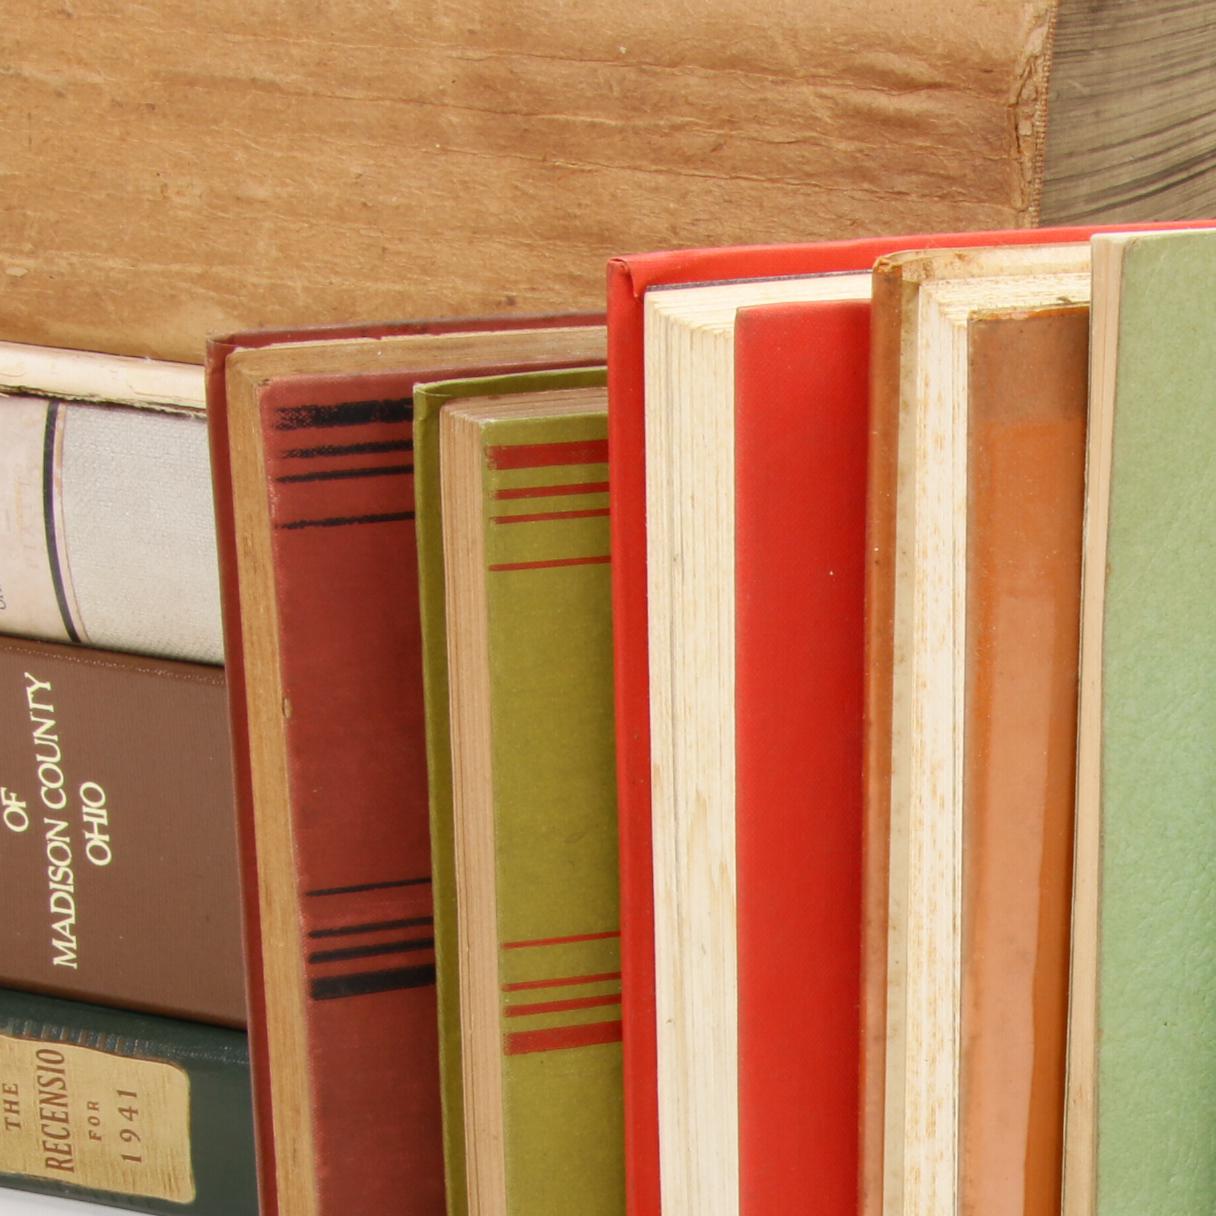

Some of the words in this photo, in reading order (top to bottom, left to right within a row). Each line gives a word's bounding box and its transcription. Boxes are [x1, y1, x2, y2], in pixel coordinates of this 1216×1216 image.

[24, 671, 67, 811] COUNTY
[0, 786, 29, 833] OF
[79, 781, 112, 866] OHIO
[44, 817, 78, 969] MADISON
[2, 1082, 22, 1131] THE
[35, 1048, 75, 1173] RECENSIO
[86, 1100, 103, 1142] FOR
[116, 1089, 142, 1163] 1941
